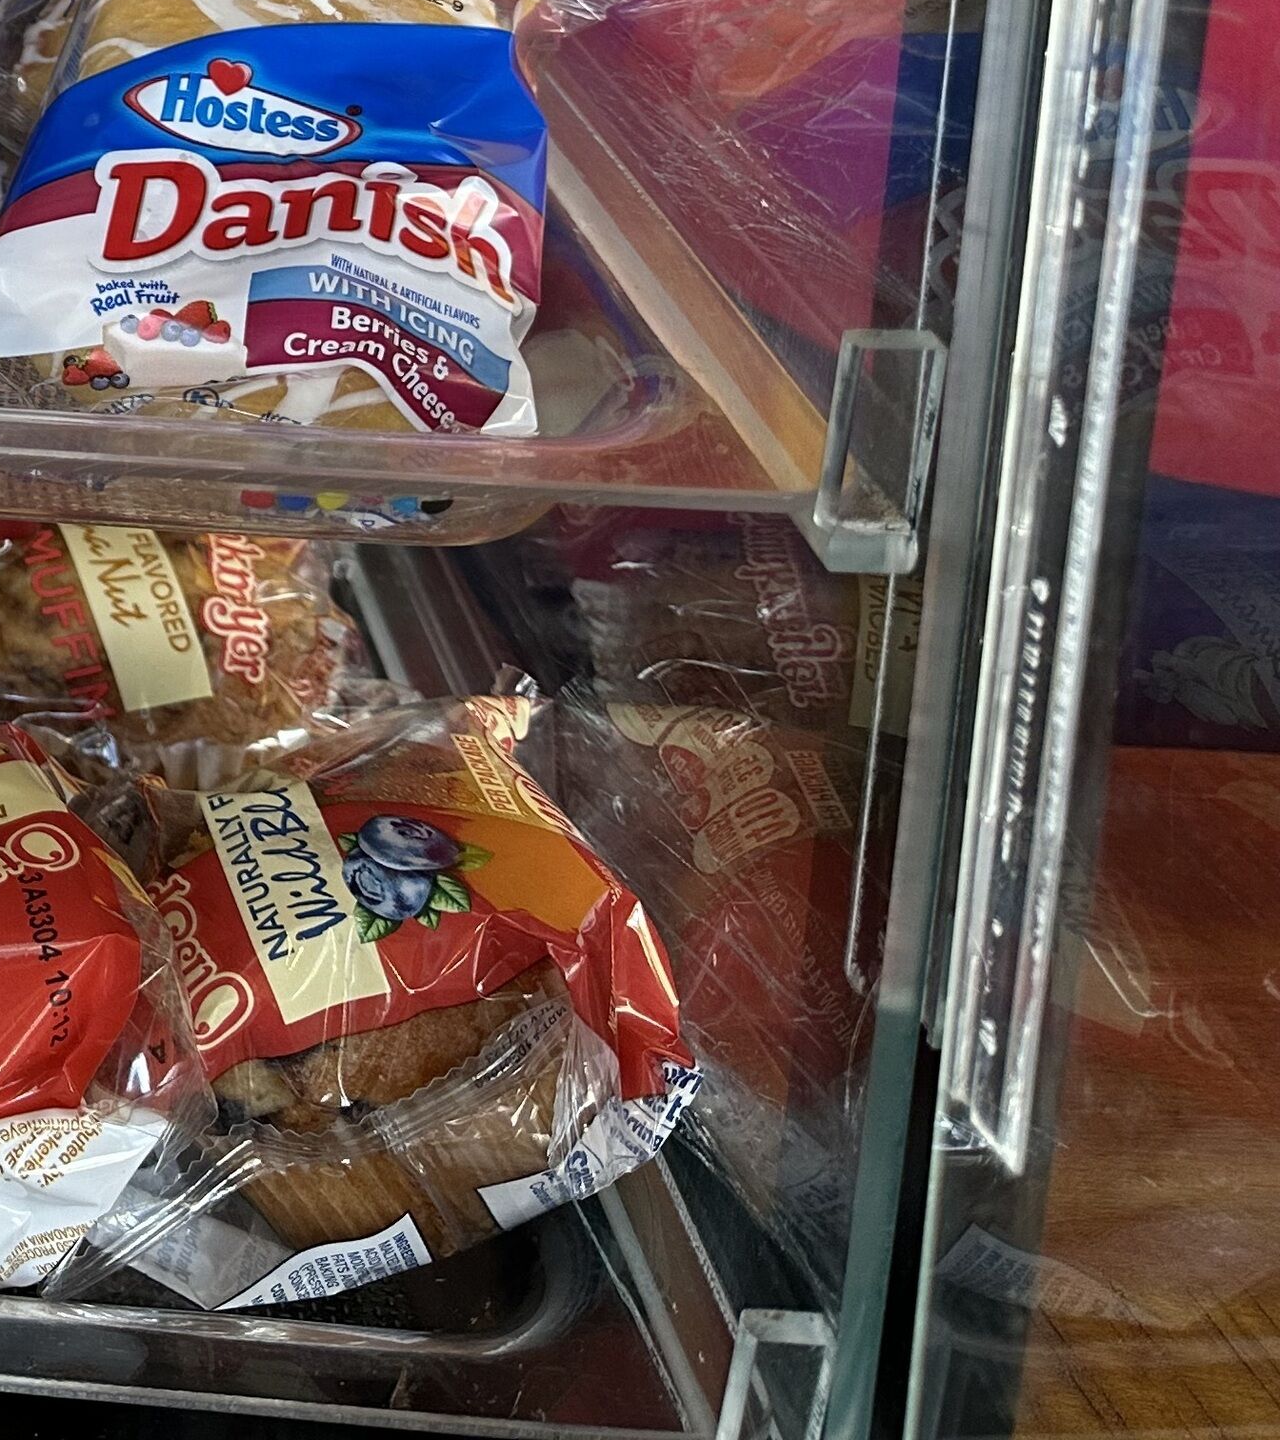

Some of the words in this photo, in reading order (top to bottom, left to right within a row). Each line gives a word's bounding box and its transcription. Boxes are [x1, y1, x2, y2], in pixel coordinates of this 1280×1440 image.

[160, 73, 341, 143] Hostess
[102, 160, 516, 304] Danish
[90, 288, 133, 317] Real
[135, 288, 181, 306] Fruit
[95, 279, 136, 295] baked
[138, 279, 169, 292] with
[308, 271, 393, 316] WITH
[397, 305, 476, 365] ICING
[331, 254, 354, 274] WITH
[354, 261, 391, 292] NATURAL
[398, 284, 443, 316] ARTIFICIAL
[442, 303, 481, 329] FLAVORS
[283, 332, 386, 360] Cream
[390, 350, 456, 430] Cheese
[330, 307, 431, 366] Berries
[432, 355, 450, 382] &
[20, 530, 116, 718] MUFFIN
[90, 558, 148, 627] Nut
[125, 533, 191, 653] FLAVORED
[456, 735, 500, 786] PACKAGE
[489, 784, 517, 814] PER
[213, 814, 295, 962] NATURALLY
